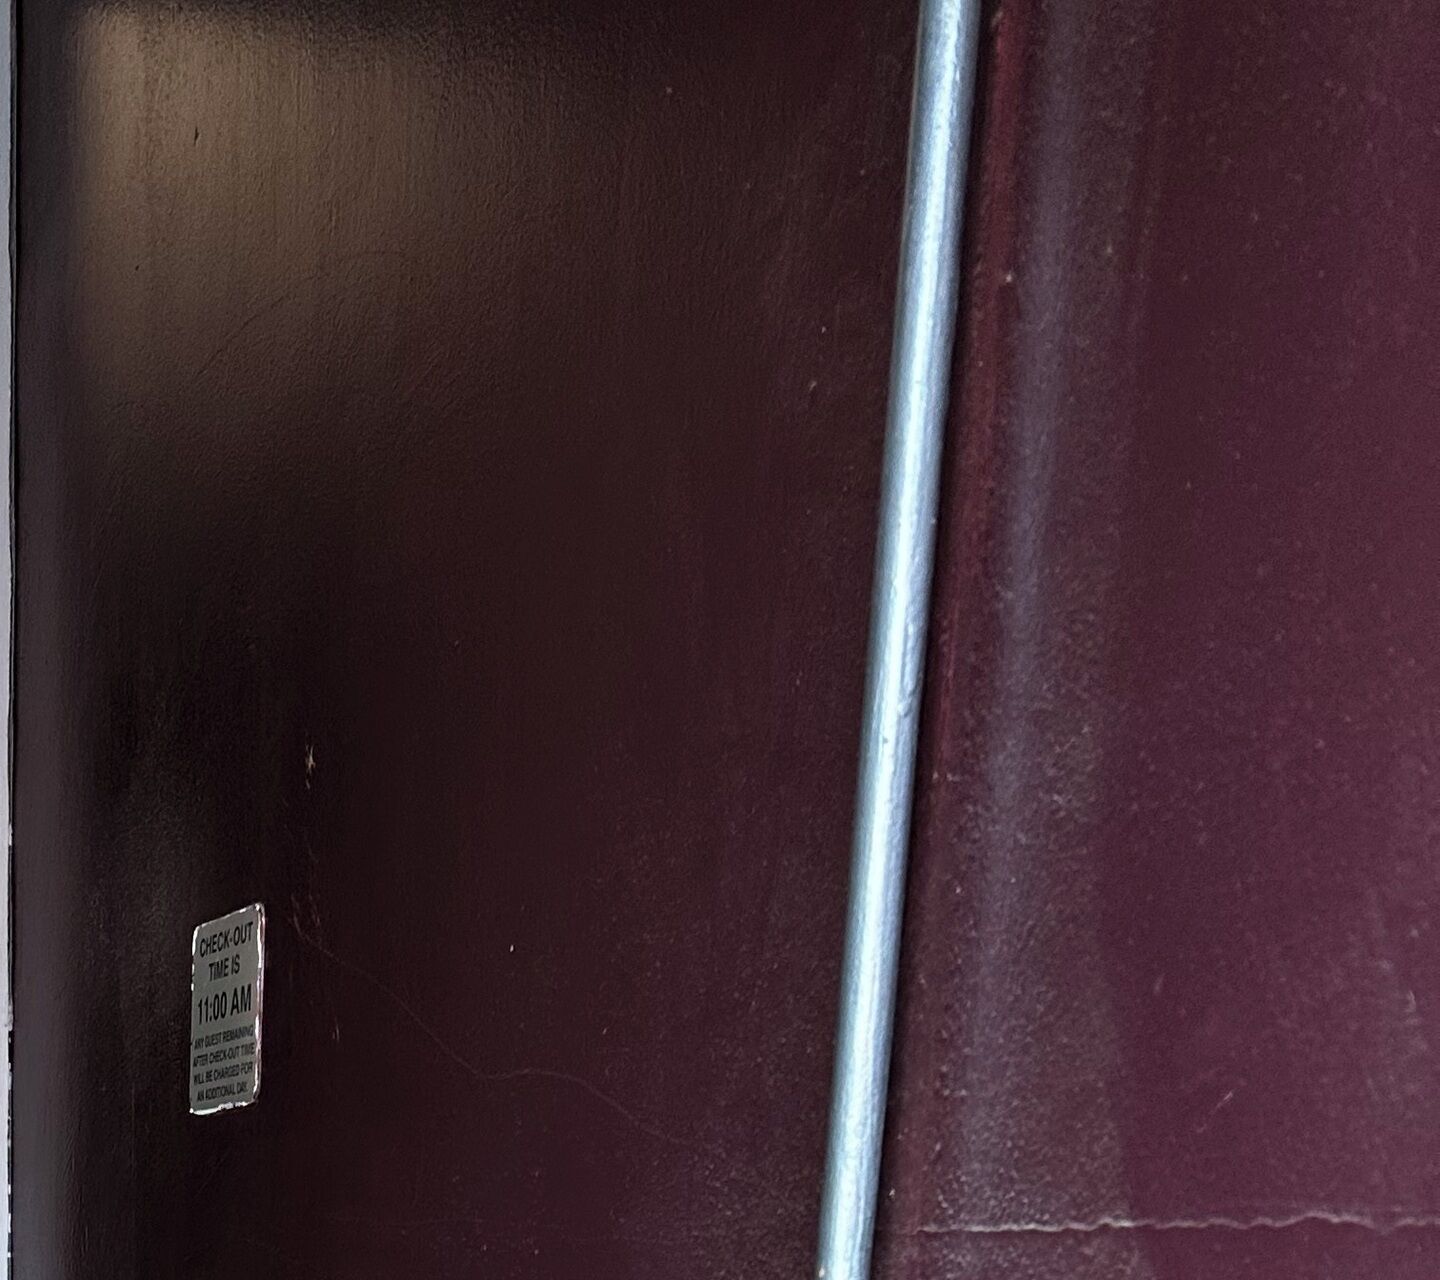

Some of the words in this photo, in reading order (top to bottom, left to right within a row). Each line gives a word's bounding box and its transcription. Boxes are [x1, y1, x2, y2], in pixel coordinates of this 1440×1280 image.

[200, 921, 254, 958] CHECK-OUT
[208, 957, 229, 982] TIME
[231, 954, 241, 976] IS
[198, 991, 227, 1024] 11:00
[230, 983, 252, 1016] AM
[194, 1038, 204, 1050] ANY
[205, 1032, 221, 1048] GUEST
[223, 1024, 254, 1042] REMAINING
[193, 1053, 208, 1067] AFTER
[209, 1045, 240, 1064] CHECK-OUT
[241, 1042, 255, 1057] TIME
[193, 1073, 204, 1085] WILL
[205, 1069, 213, 1083] BE
[214, 1064, 240, 1082] CHARGED
[241, 1061, 253, 1075] FOR
[197, 1089, 205, 1101] AN
[206, 1083, 236, 1101] ADDITIONAL
